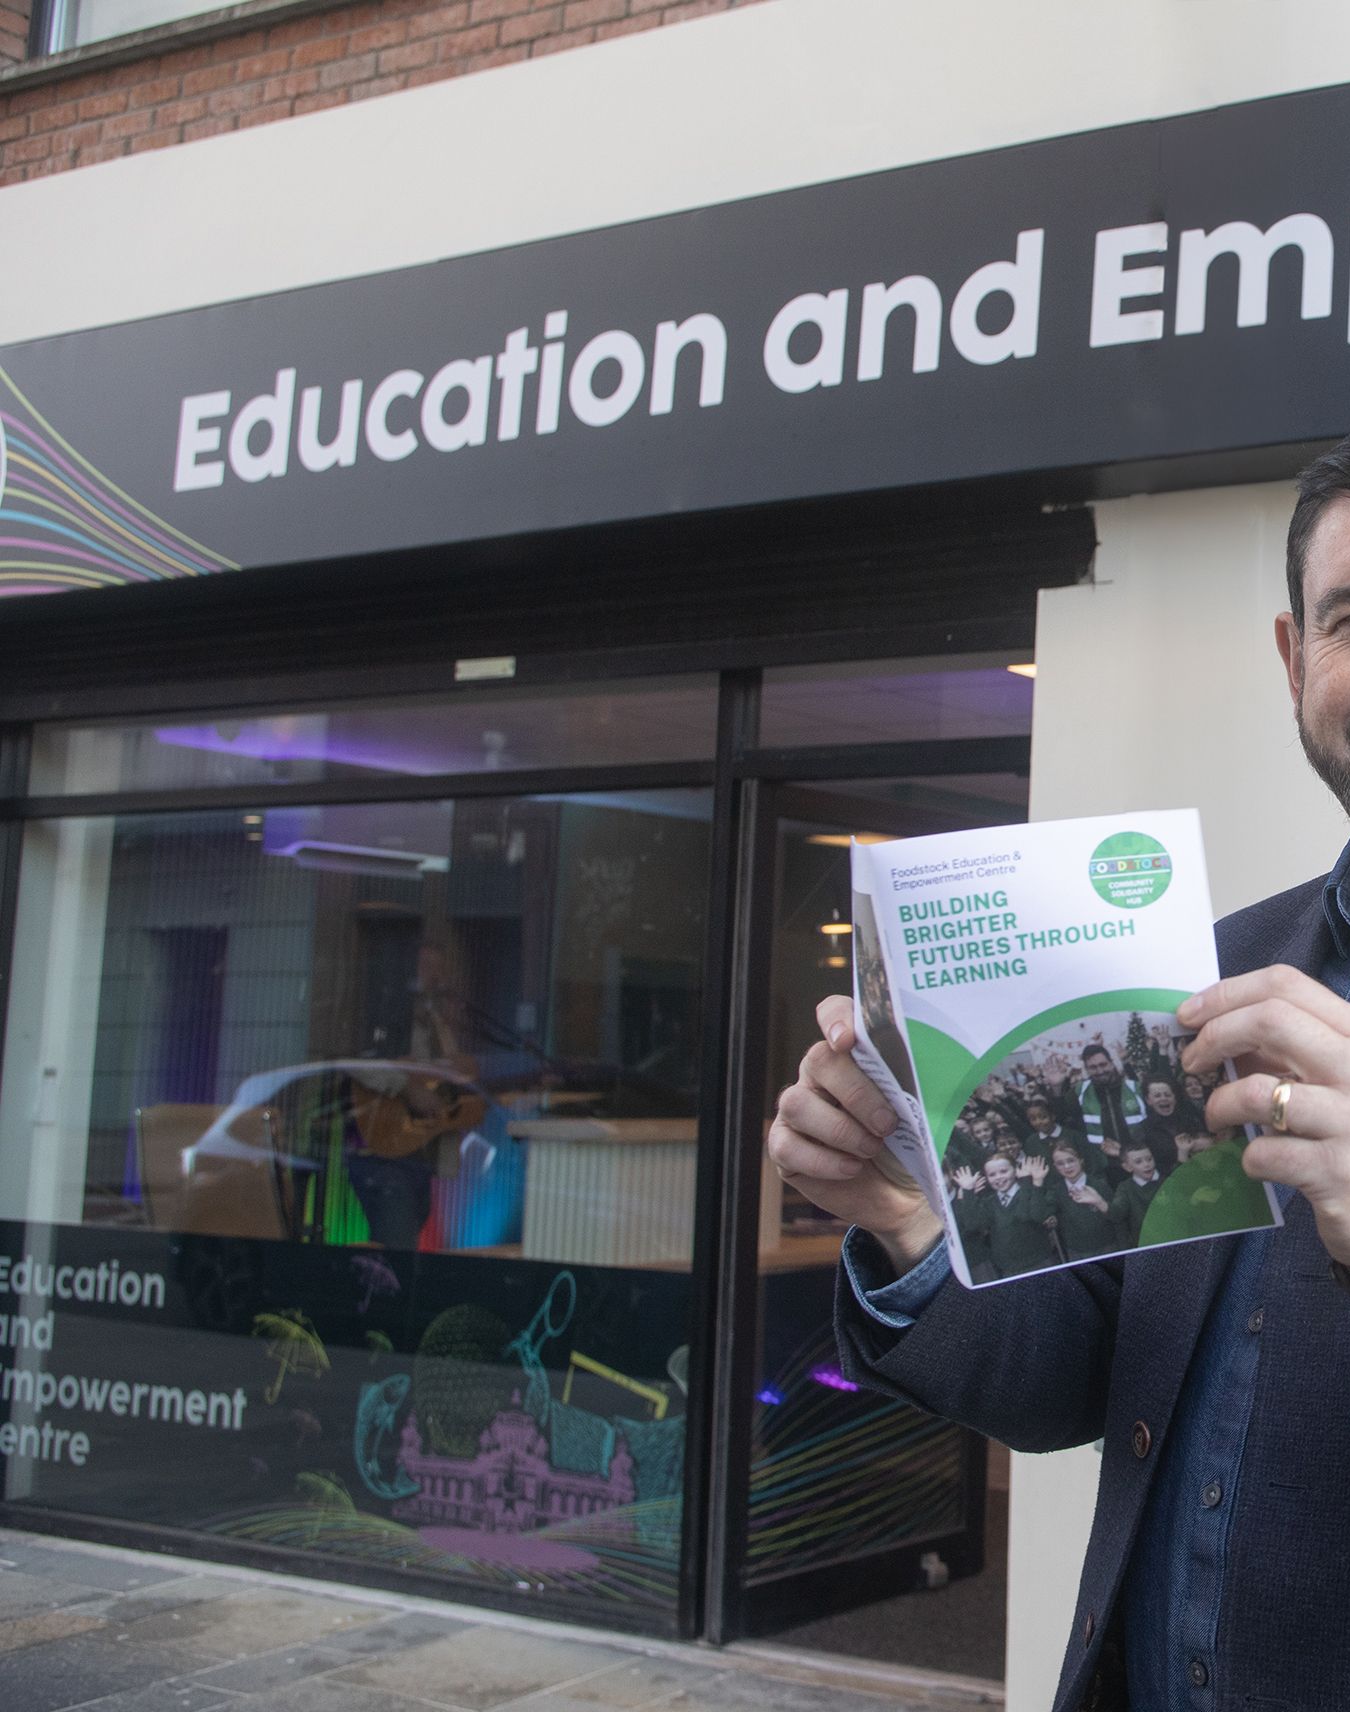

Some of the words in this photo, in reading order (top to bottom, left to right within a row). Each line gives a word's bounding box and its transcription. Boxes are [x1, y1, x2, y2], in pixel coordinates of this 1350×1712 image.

[174, 309, 727, 492] Education
[764, 228, 1044, 393] and
[890, 861, 949, 879] Foodstock
[952, 853, 1011, 869] Education
[1012, 850, 1021, 861] &
[893, 870, 974, 891] Empowerment
[976, 865, 1016, 879] Centre
[899, 890, 1009, 923] BUILDING
[903, 912, 1018, 945] BRIGHTER
[908, 937, 1011, 968] FUTURES
[1015, 919, 1136, 951] THROUGH
[912, 958, 1028, 990] LEARNING
[0, 1364, 247, 1430] mpowerment
[0, 1420, 91, 1466] entre
